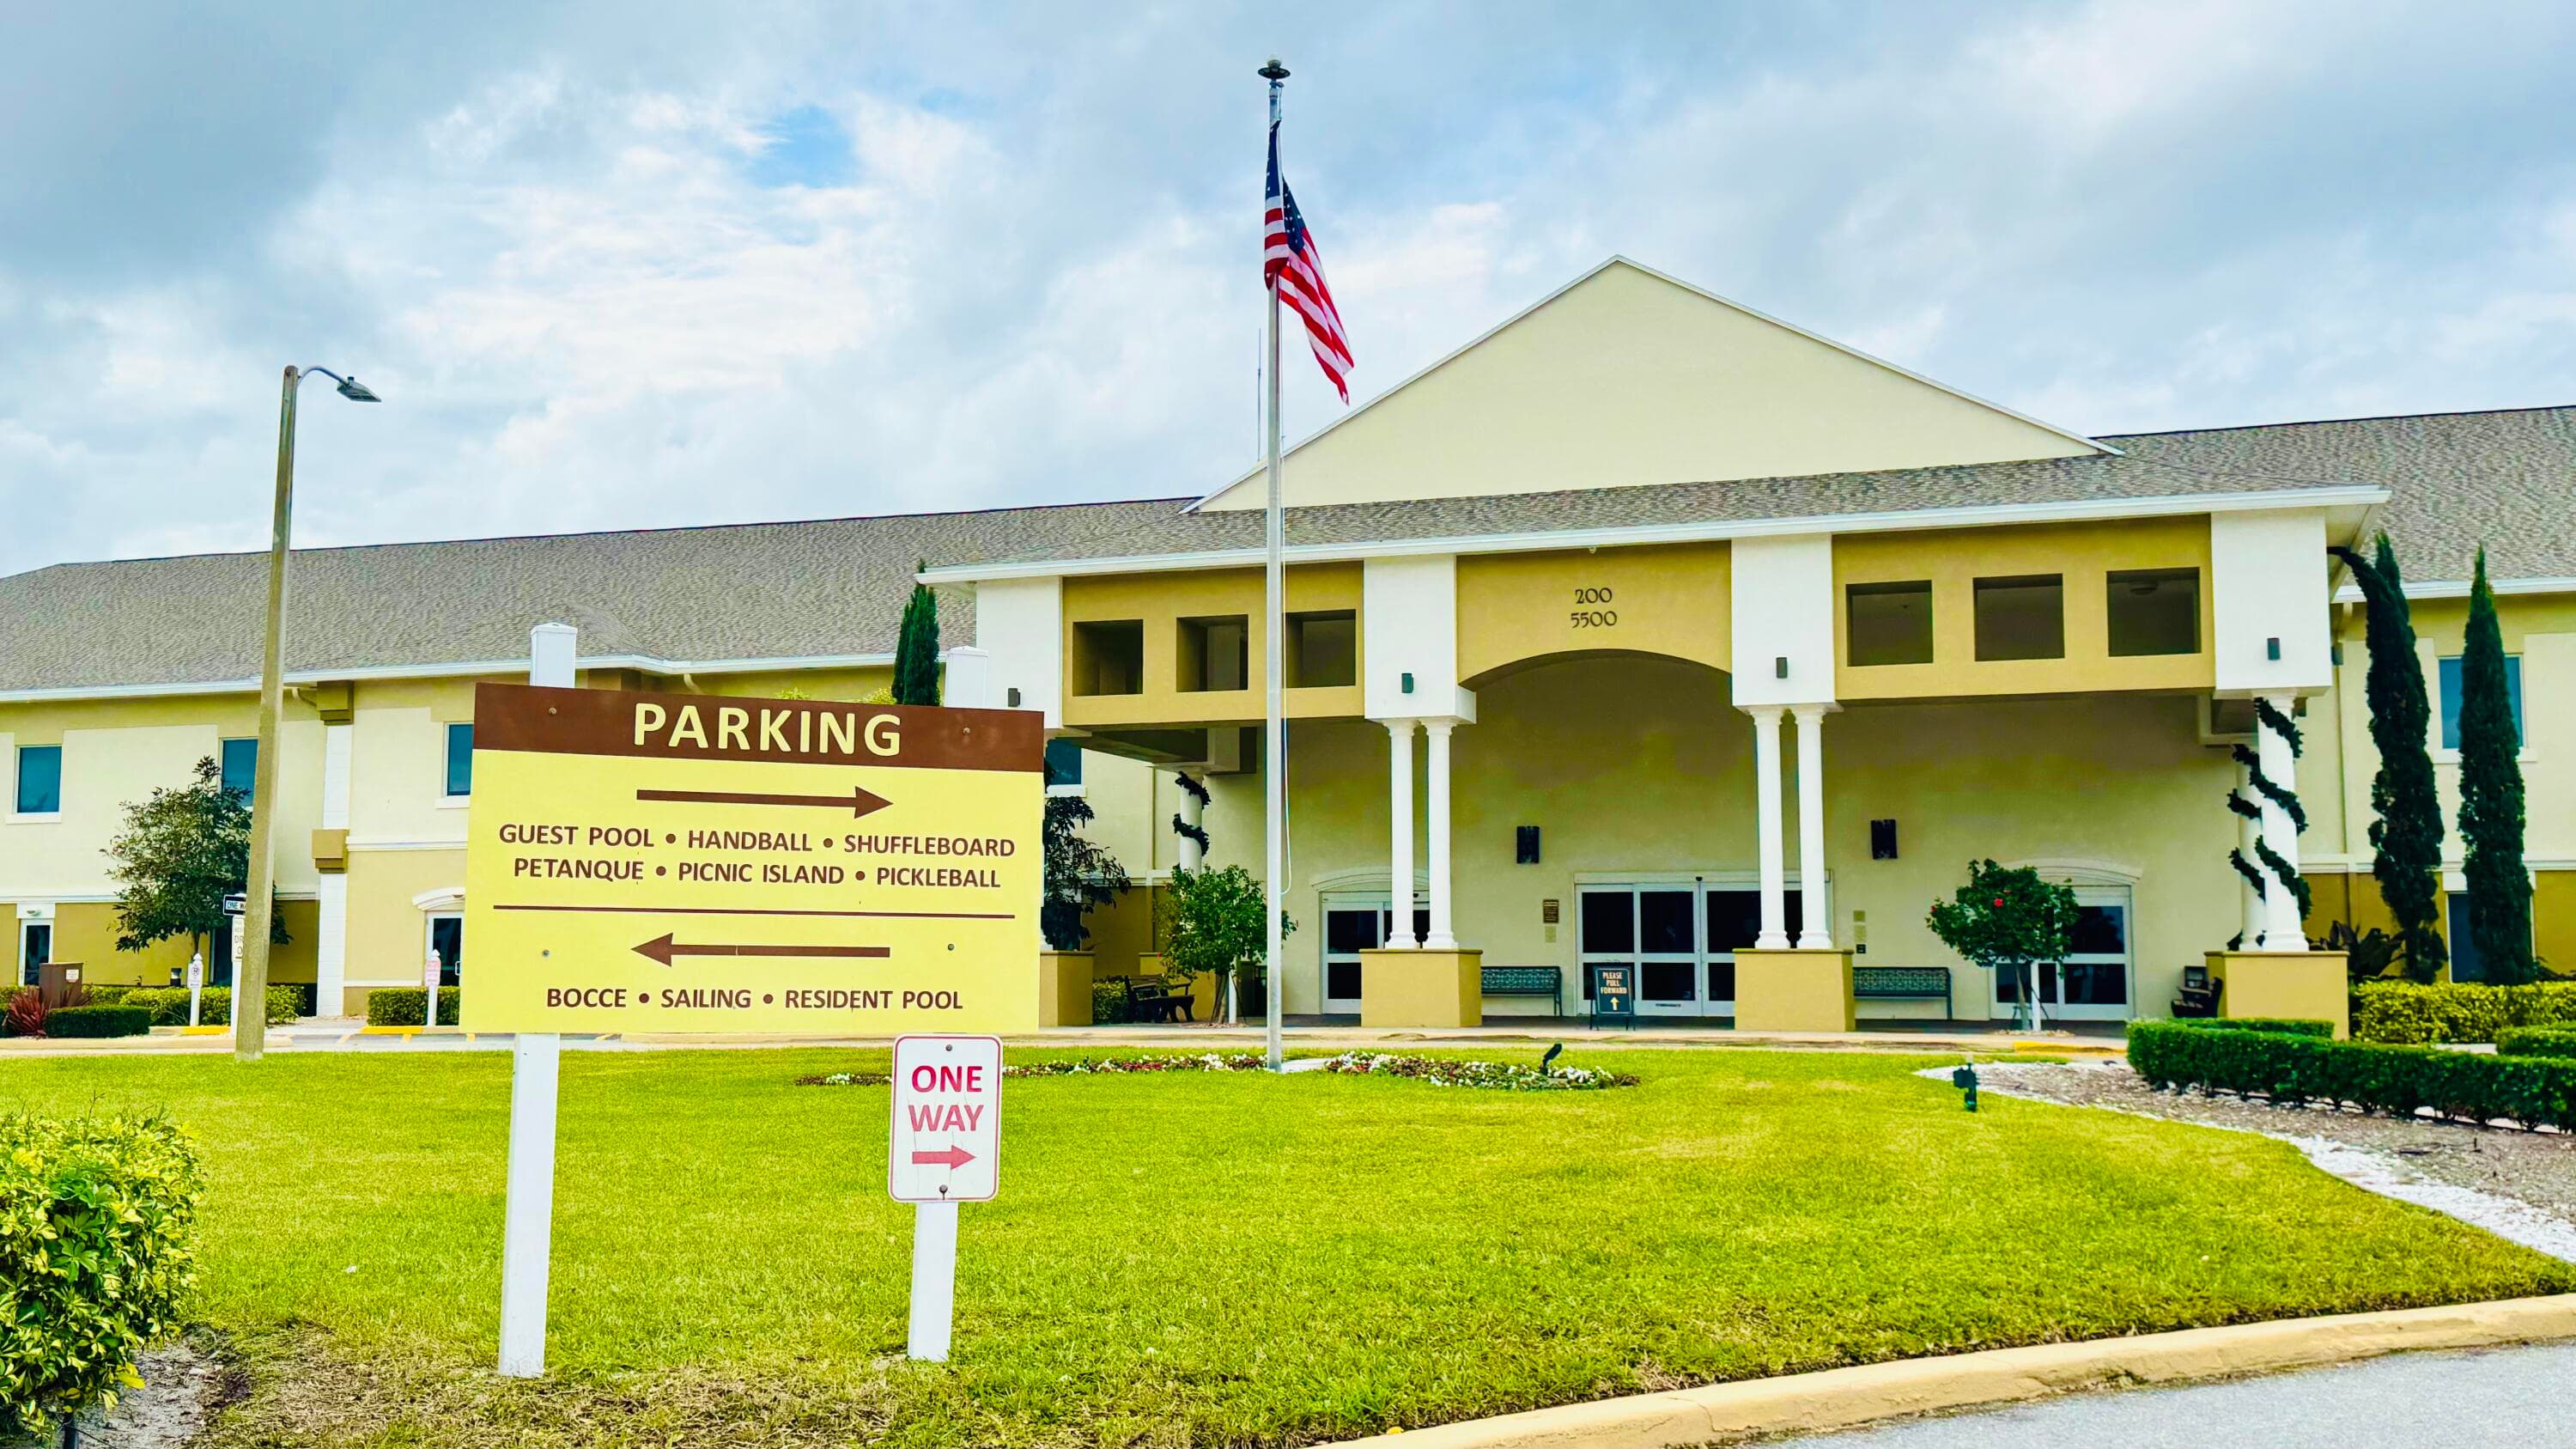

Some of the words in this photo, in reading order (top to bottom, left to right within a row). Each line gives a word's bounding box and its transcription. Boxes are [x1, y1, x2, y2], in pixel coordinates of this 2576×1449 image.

[1575, 587, 1613, 604] 200
[1571, 611, 1618, 628] 5500
[634, 703, 901, 757] PARKING
[499, 824, 580, 845] GUEST
[589, 826, 654, 848] POOL
[688, 830, 813, 852] HANDBALL
[844, 834, 1015, 857] SHUFFLEBOARD
[514, 857, 644, 883] PETANQUE
[678, 861, 753, 883] PICNIC
[762, 864, 844, 885] ISLAND
[877, 867, 1001, 888] PICKLEBALL
[547, 988, 628, 1008] BOCCE
[660, 989, 751, 1008] SAILING
[785, 989, 894, 1009] RESIDENT
[902, 990, 963, 1010] POOL
[911, 1065, 983, 1093] ONE
[908, 1105, 984, 1131] WAY
